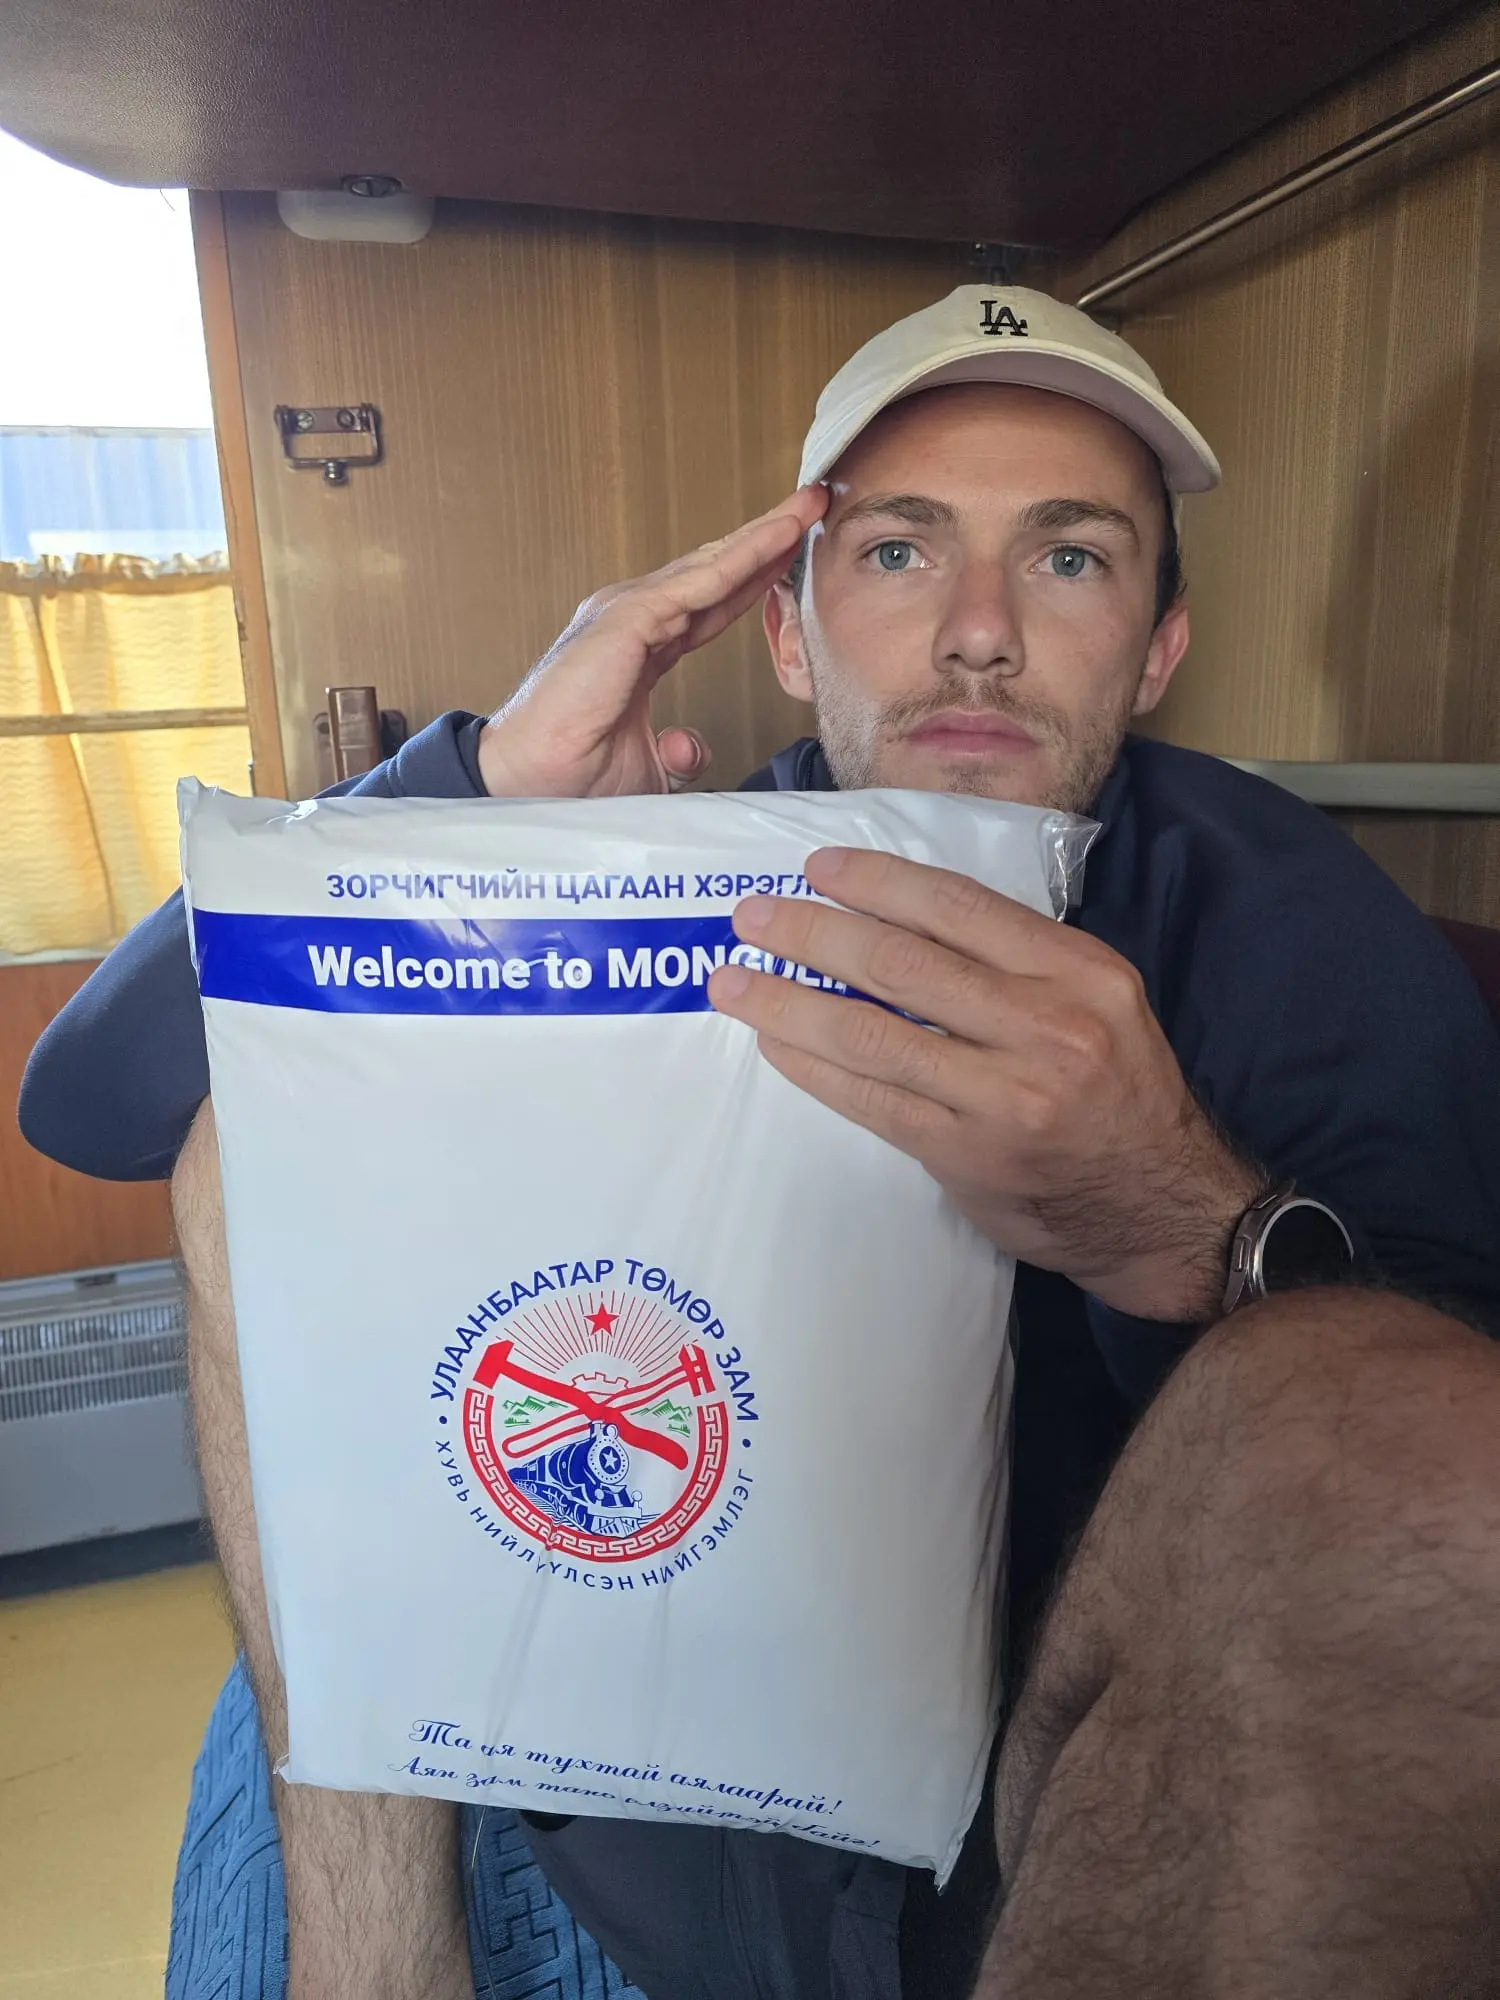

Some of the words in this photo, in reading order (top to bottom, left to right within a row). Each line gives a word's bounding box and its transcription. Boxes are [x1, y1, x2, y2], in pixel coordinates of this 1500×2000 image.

[980, 300, 1028, 336] LA
[326, 868, 545, 899] ЗОРЧИГЧИЙН
[556, 873, 684, 903] ЦАГААН
[694, 873, 827, 898] ХЭРЭГЛ
[307, 944, 531, 990] Welcome
[544, 951, 593, 990] to
[430, 1259, 614, 1402] УЛААНБААТАР
[624, 1258, 726, 1342] ТӨМӨР
[715, 1346, 760, 1422] ЗАМ
[435, 1439, 470, 1503] ХУВЬ
[641, 1468, 755, 1584] НИЙГЭМЛЭГ
[387, 1756, 458, 1779] Аян
[407, 1719, 473, 1750] Та
[524, 1750, 664, 1782] тухтай
[669, 1772, 843, 1816] аялаарай!
